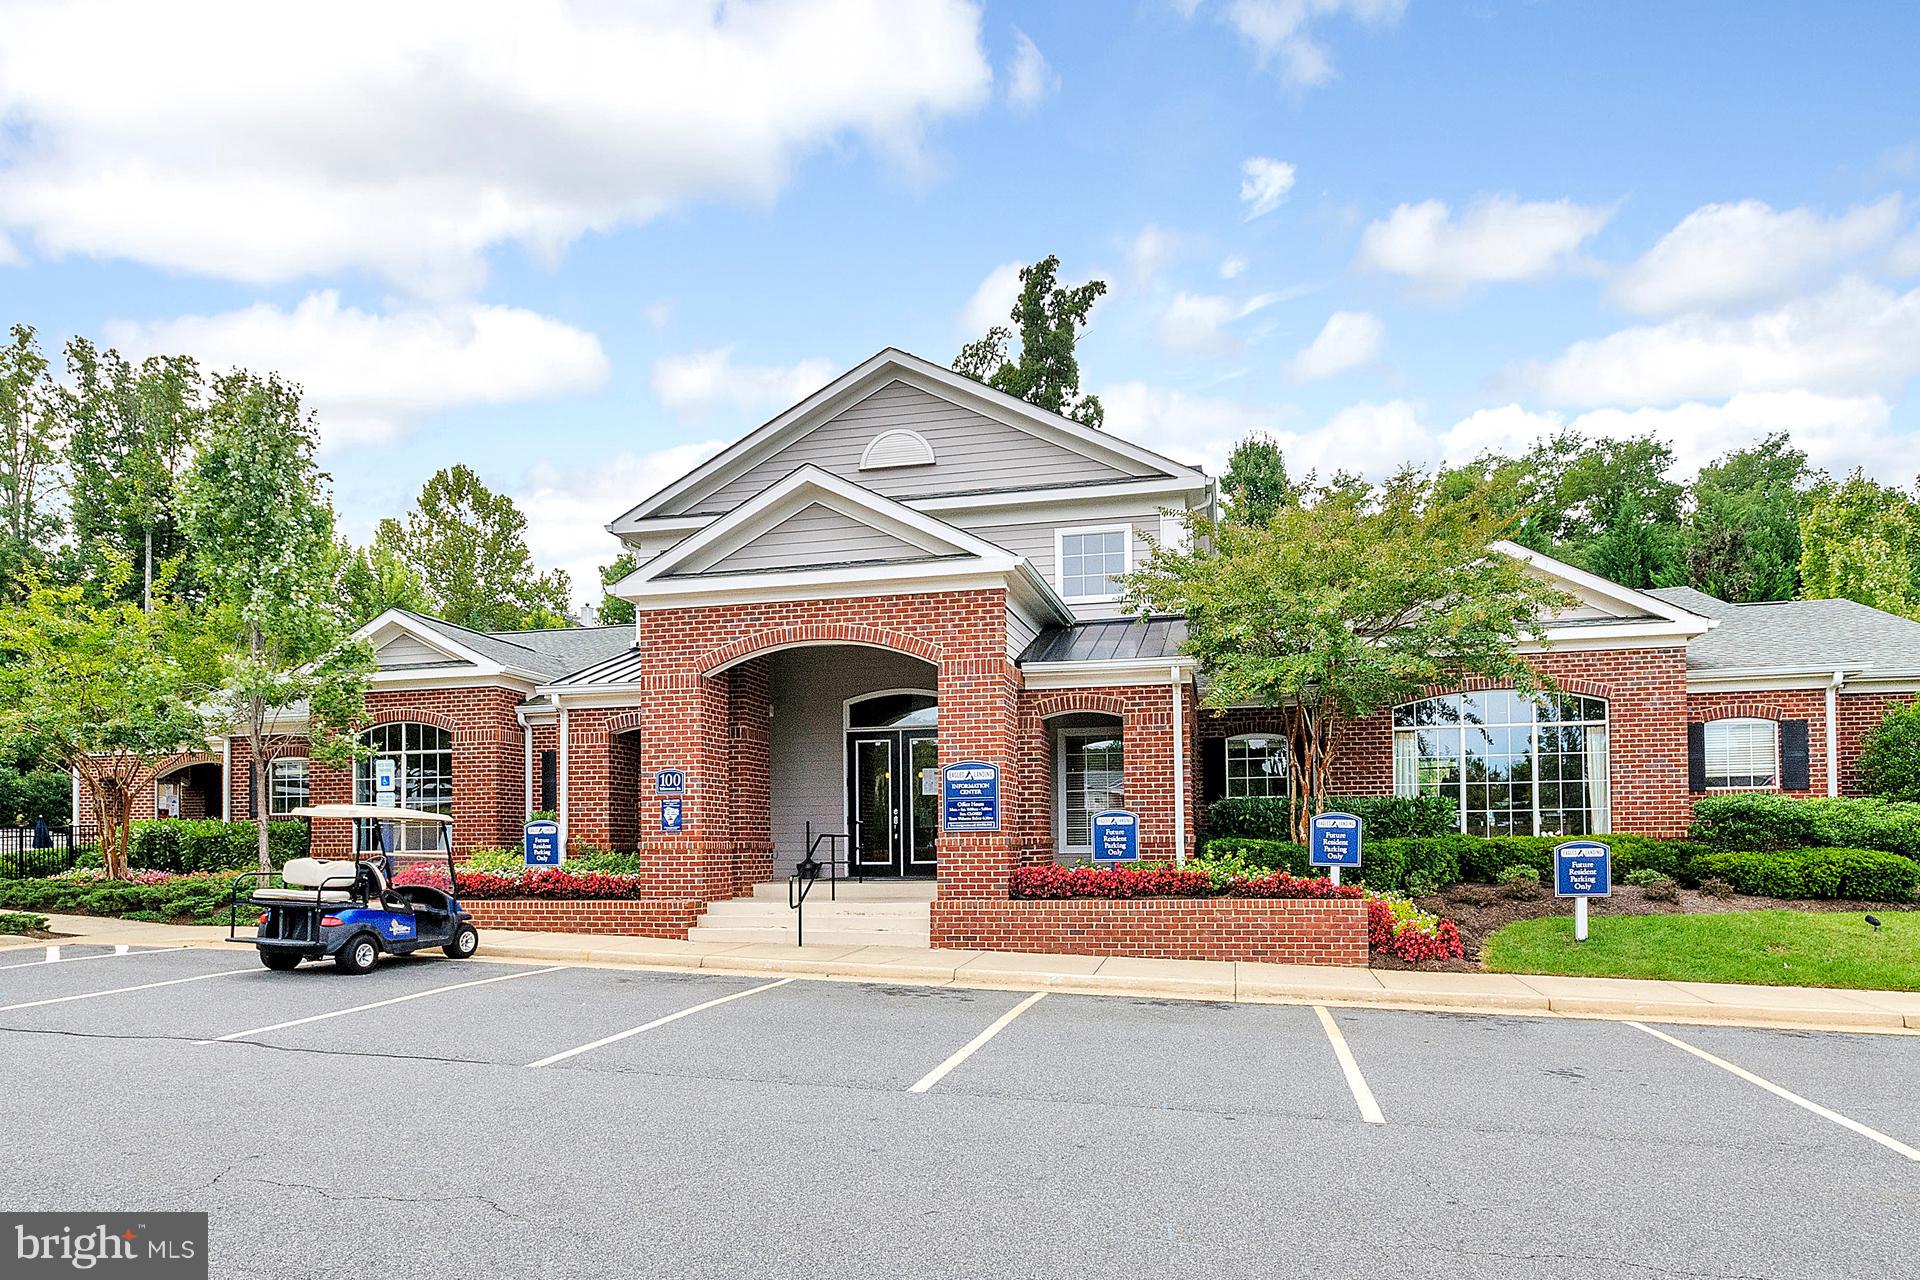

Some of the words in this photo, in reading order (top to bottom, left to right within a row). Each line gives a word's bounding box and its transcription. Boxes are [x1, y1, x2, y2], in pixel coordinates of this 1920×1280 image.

[660, 774, 681, 786] 100
[1107, 849, 1123, 857] Only
[1323, 846, 1348, 854] Parking
[1327, 853, 1344, 861] Only
[1570, 876, 1596, 884] Parking
[1574, 883, 1592, 891] Only
